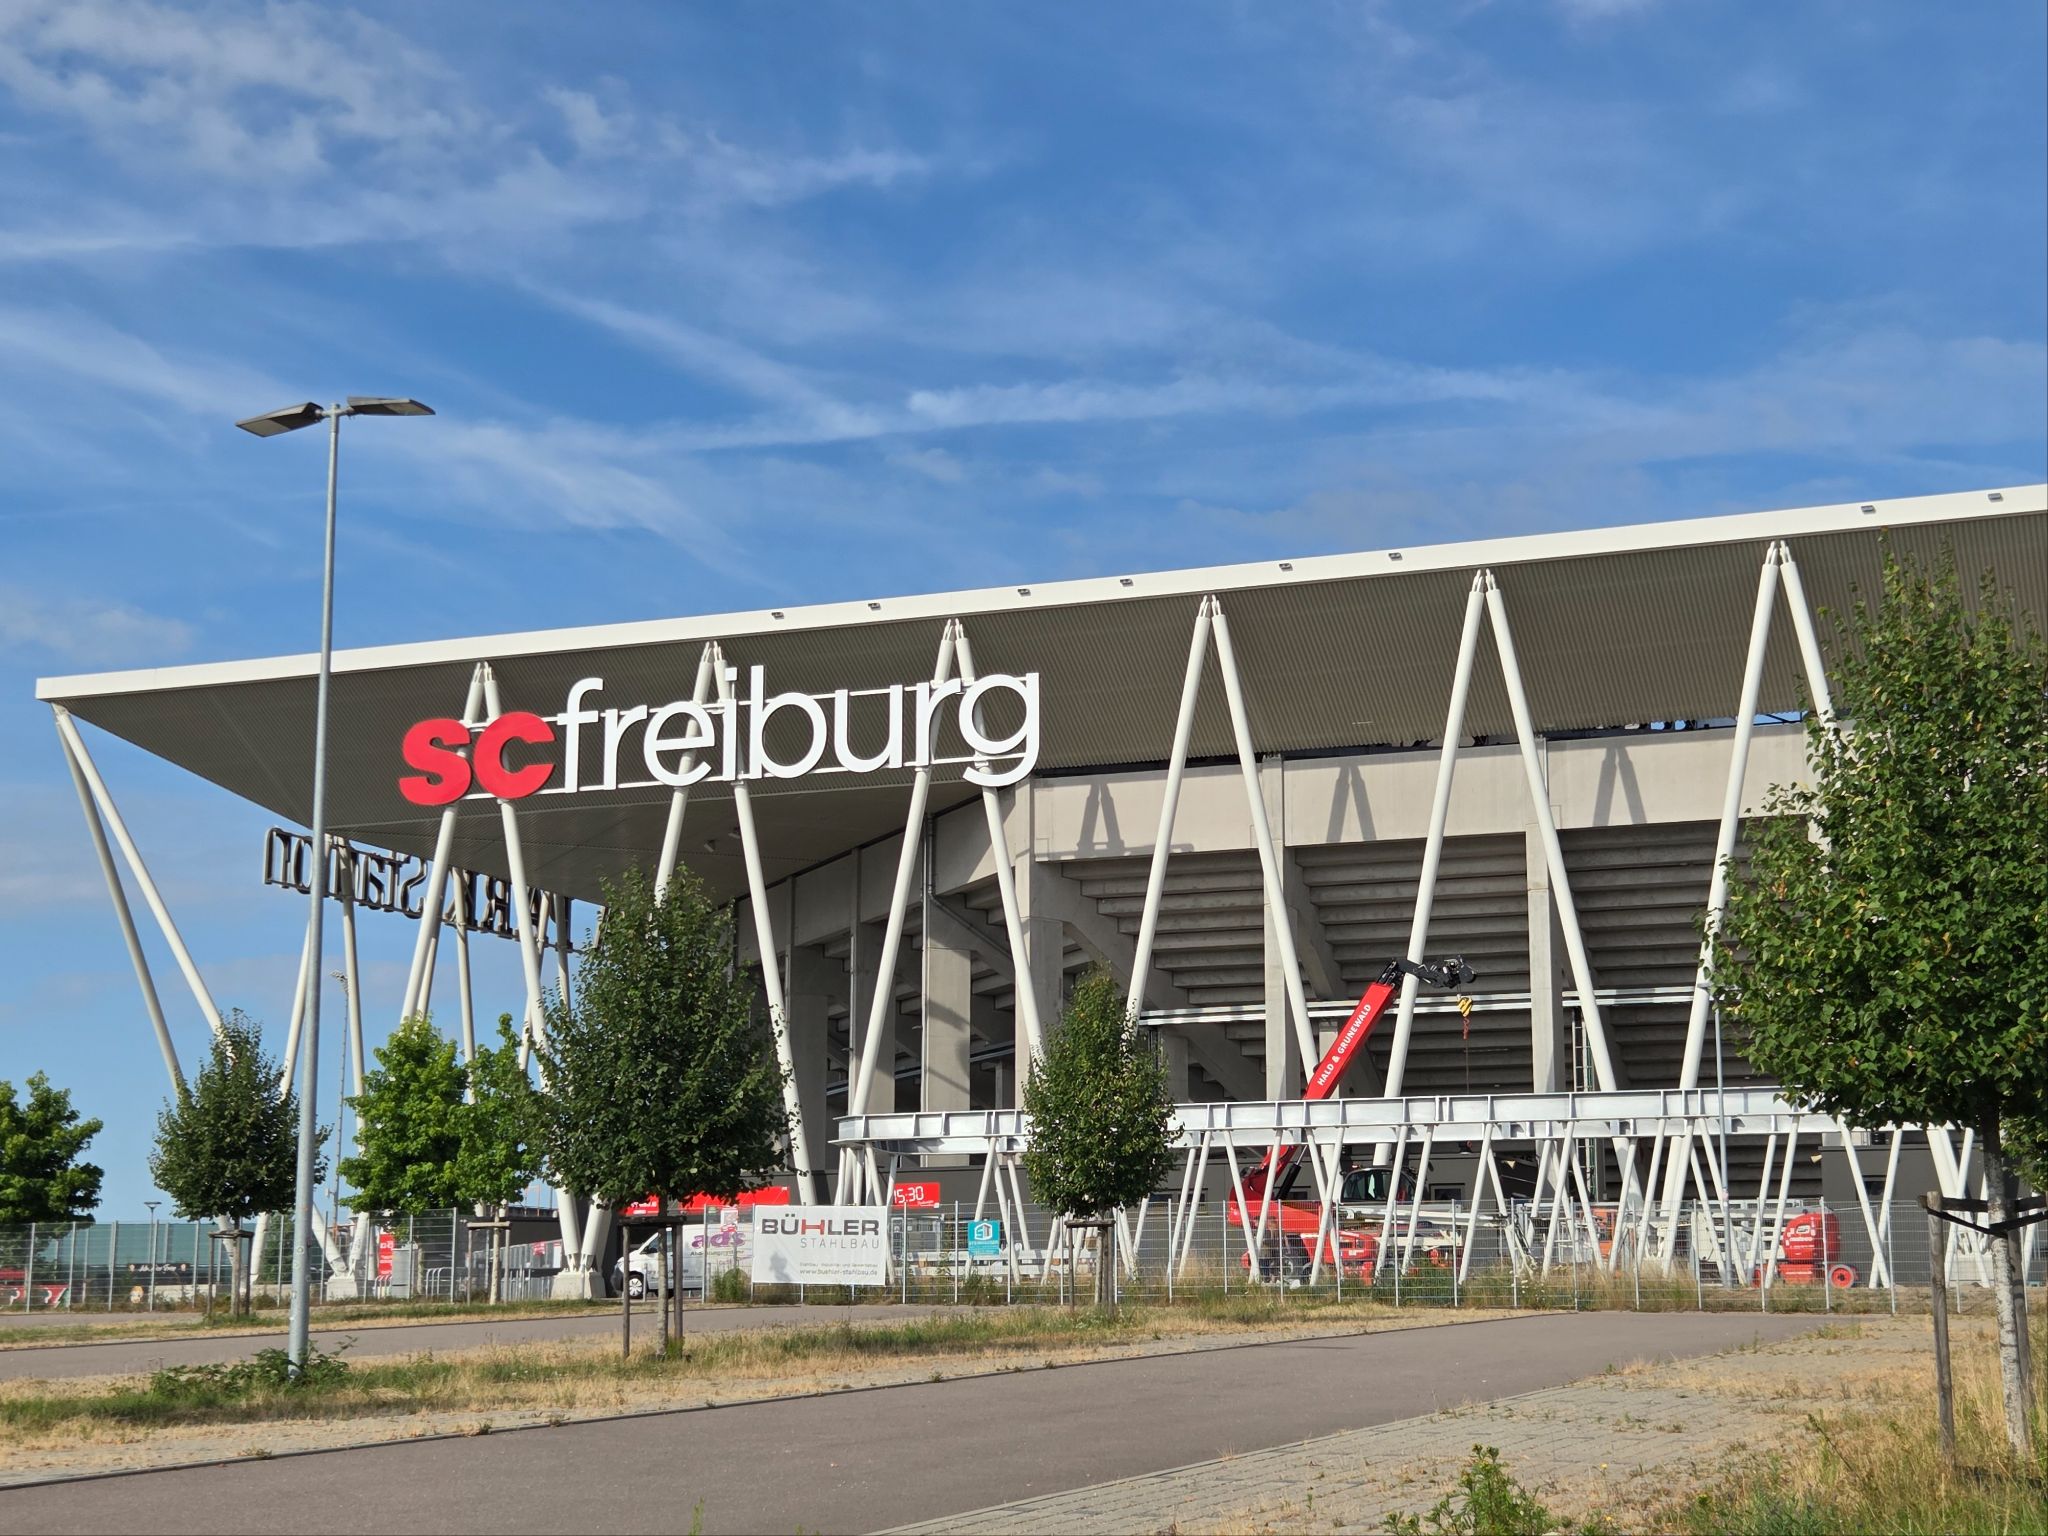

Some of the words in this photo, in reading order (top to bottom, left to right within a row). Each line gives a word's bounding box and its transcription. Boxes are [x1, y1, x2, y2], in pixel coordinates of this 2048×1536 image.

[1317, 1063, 1334, 1085] HALD
[1331, 1055, 1341, 1063] &
[761, 1213, 880, 1236] BÜHLER
[800, 1237, 880, 1249] STAHLBAU
